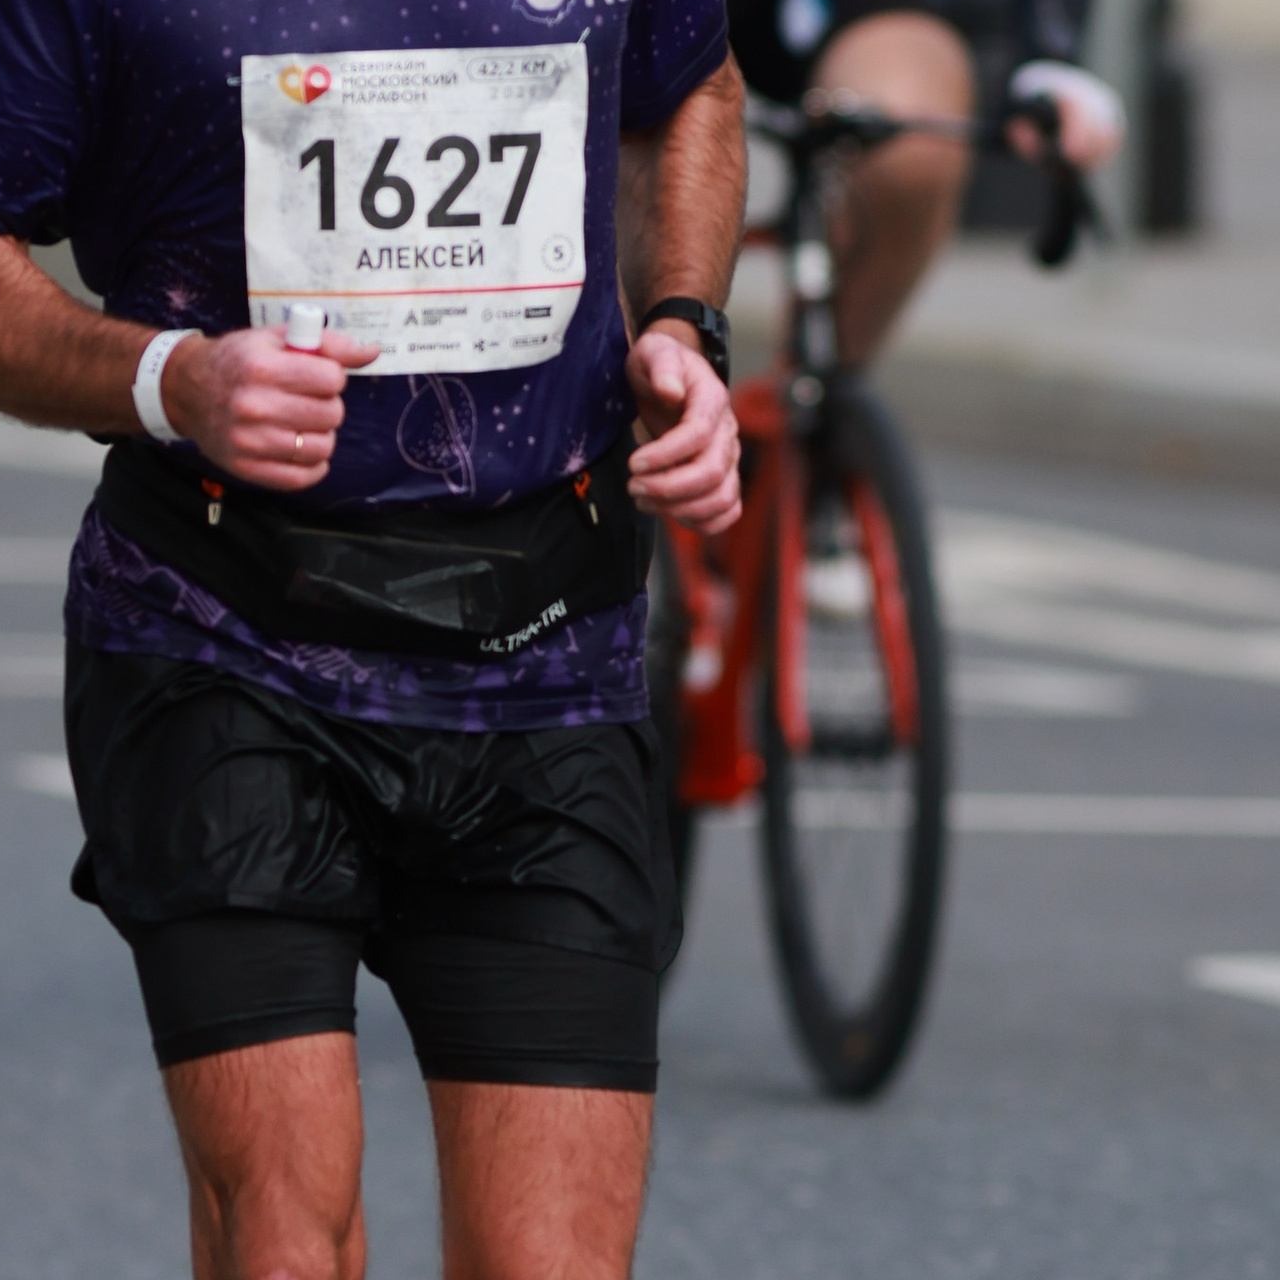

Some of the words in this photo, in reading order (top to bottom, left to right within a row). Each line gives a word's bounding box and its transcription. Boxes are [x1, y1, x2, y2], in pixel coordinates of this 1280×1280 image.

[341, 70, 459, 89] МОСКОВСКИЙ
[341, 91, 428, 104] МАРАФОН
[299, 132, 542, 231] 1627
[356, 239, 486, 270] АЛЕКСЕЙ
[552, 245, 564, 261] 5
